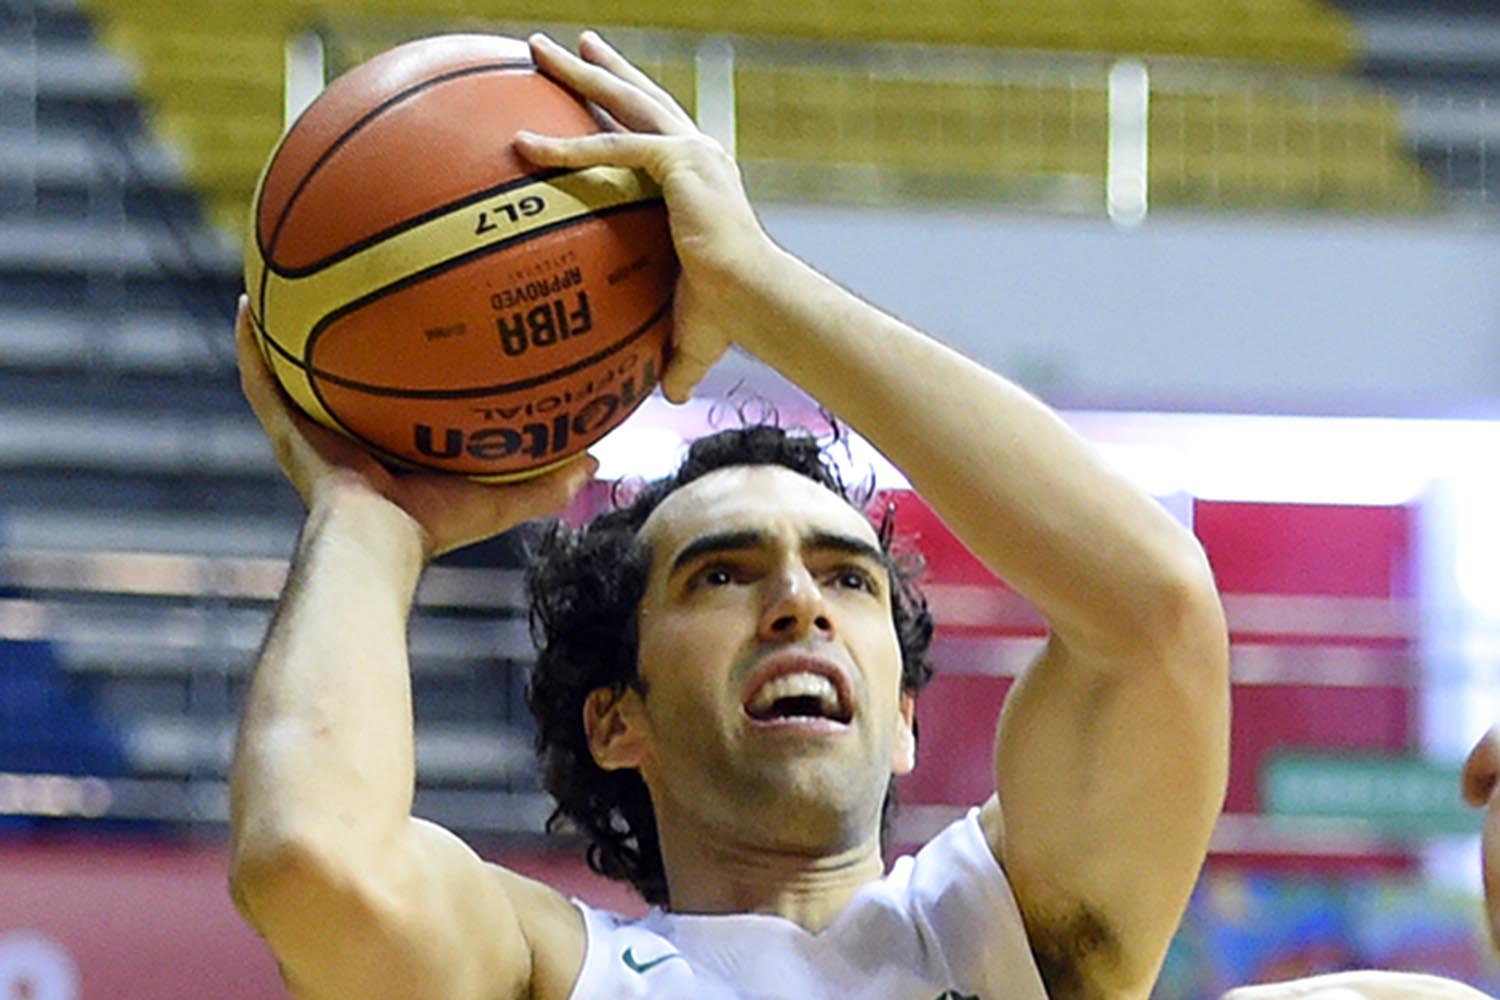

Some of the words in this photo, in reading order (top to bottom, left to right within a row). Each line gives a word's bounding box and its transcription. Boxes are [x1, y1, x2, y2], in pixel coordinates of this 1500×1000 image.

[475, 195, 545, 236] GL7
[490, 265, 583, 311] APPROVED
[496, 289, 593, 358] FIBA
